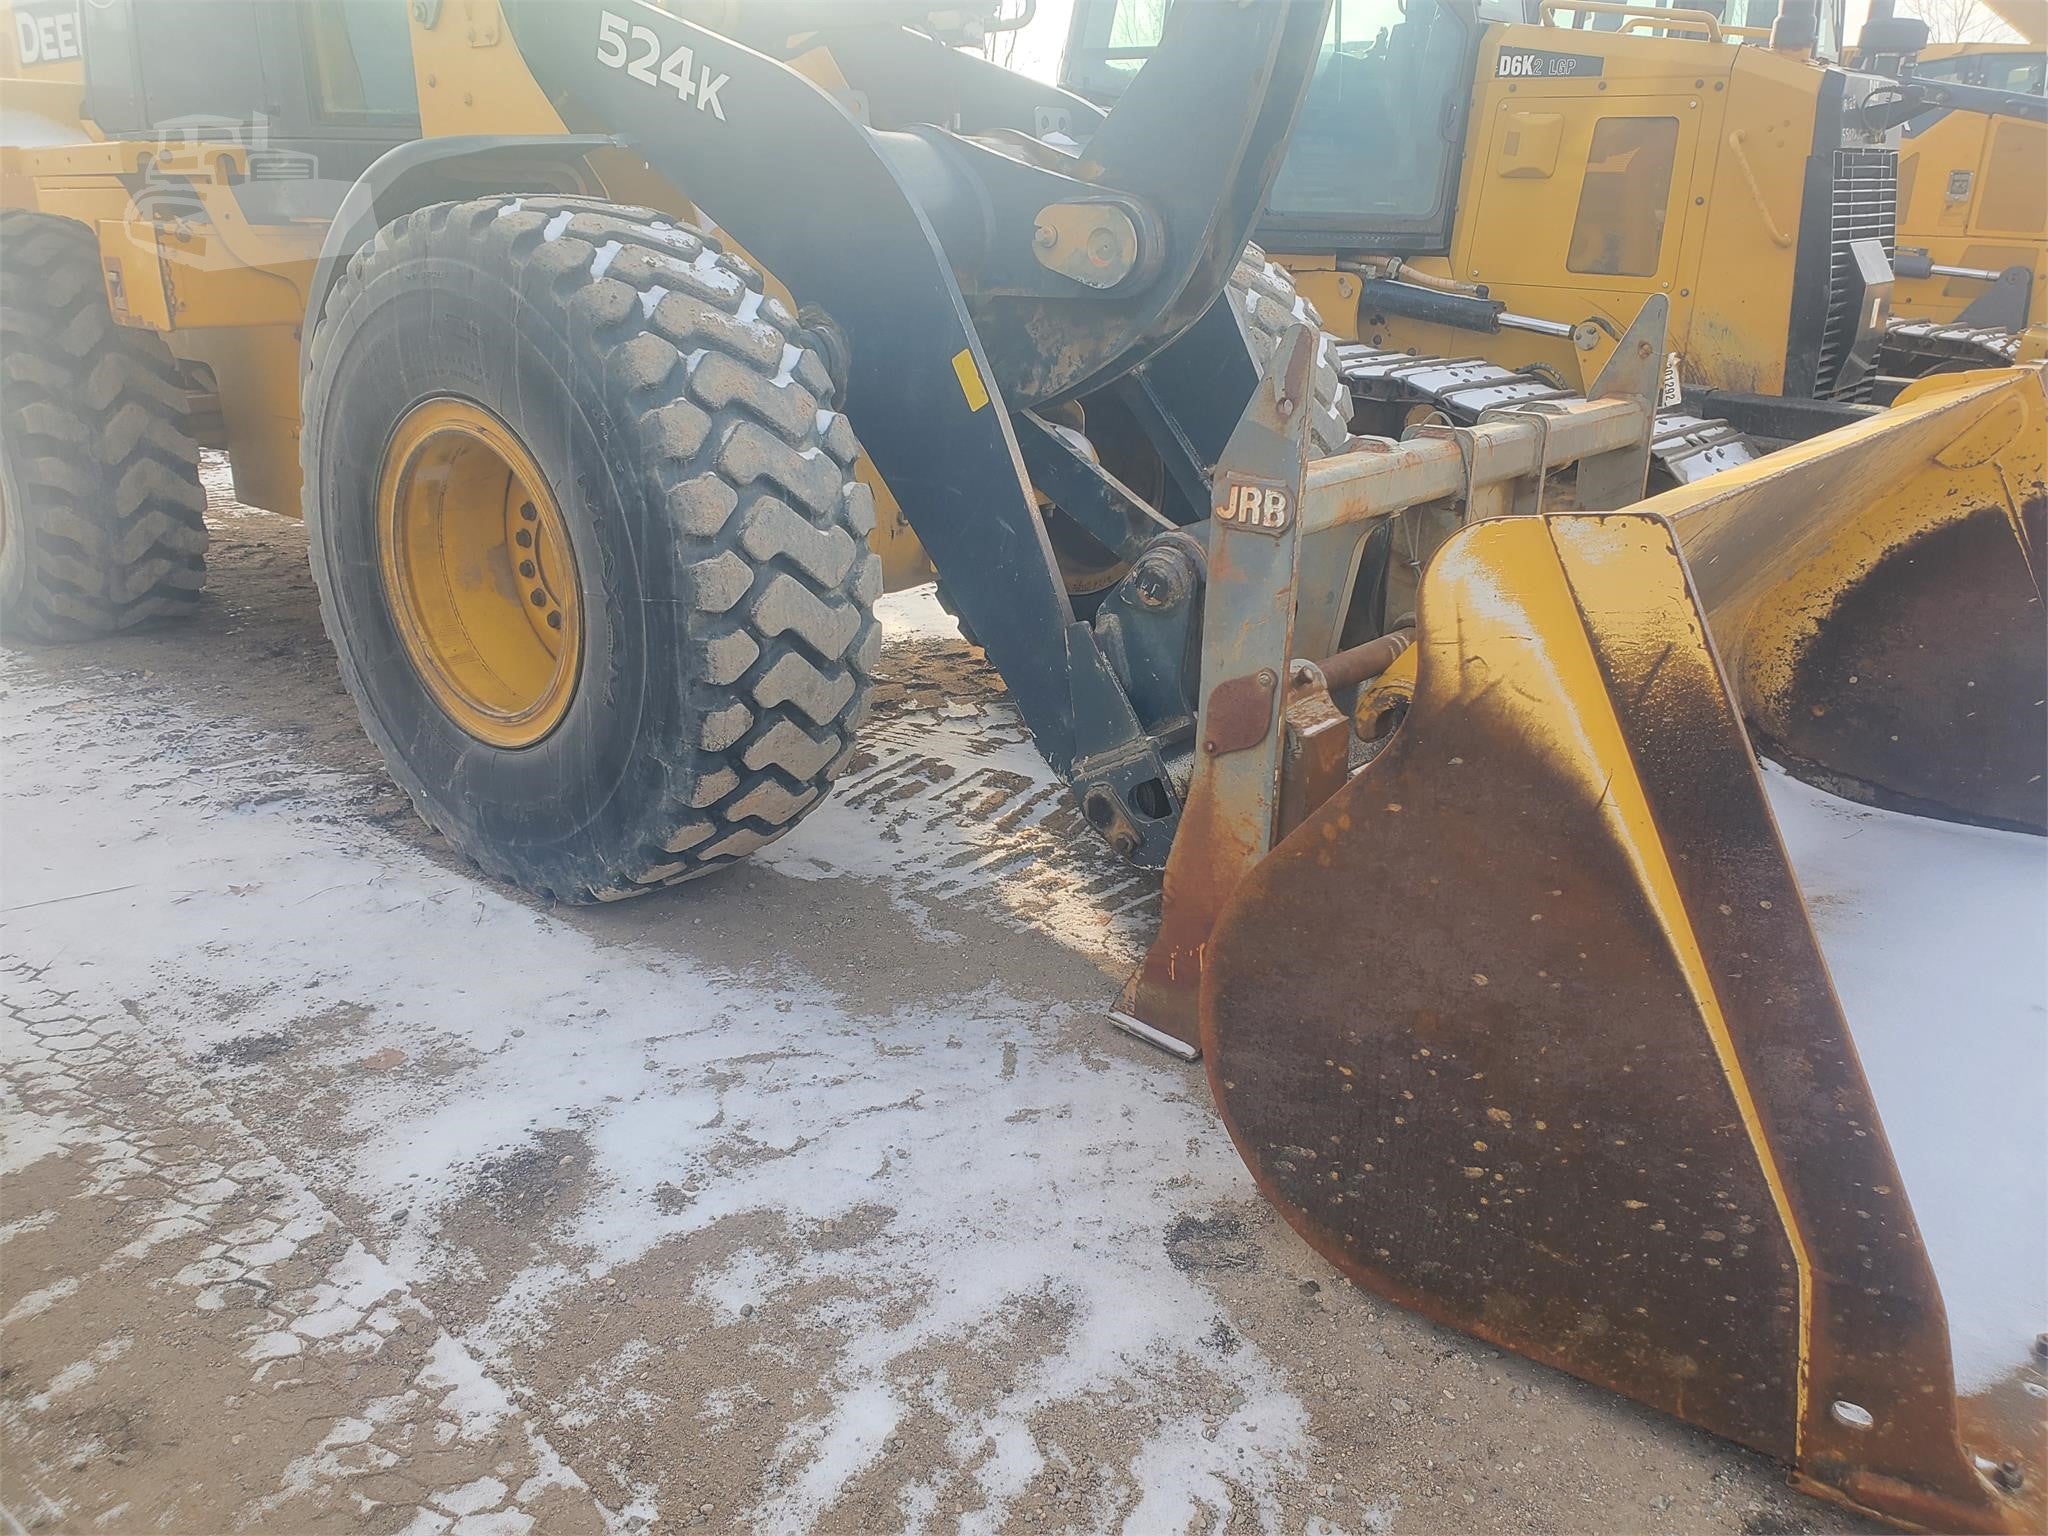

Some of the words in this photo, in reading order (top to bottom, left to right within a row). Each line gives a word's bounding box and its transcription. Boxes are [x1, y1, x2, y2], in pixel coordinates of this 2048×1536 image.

[15, 12, 82, 64] DEE
[597, 10, 731, 122] 524K
[1548, 58, 1576, 75] LGP
[1216, 486, 1287, 528] JRB
